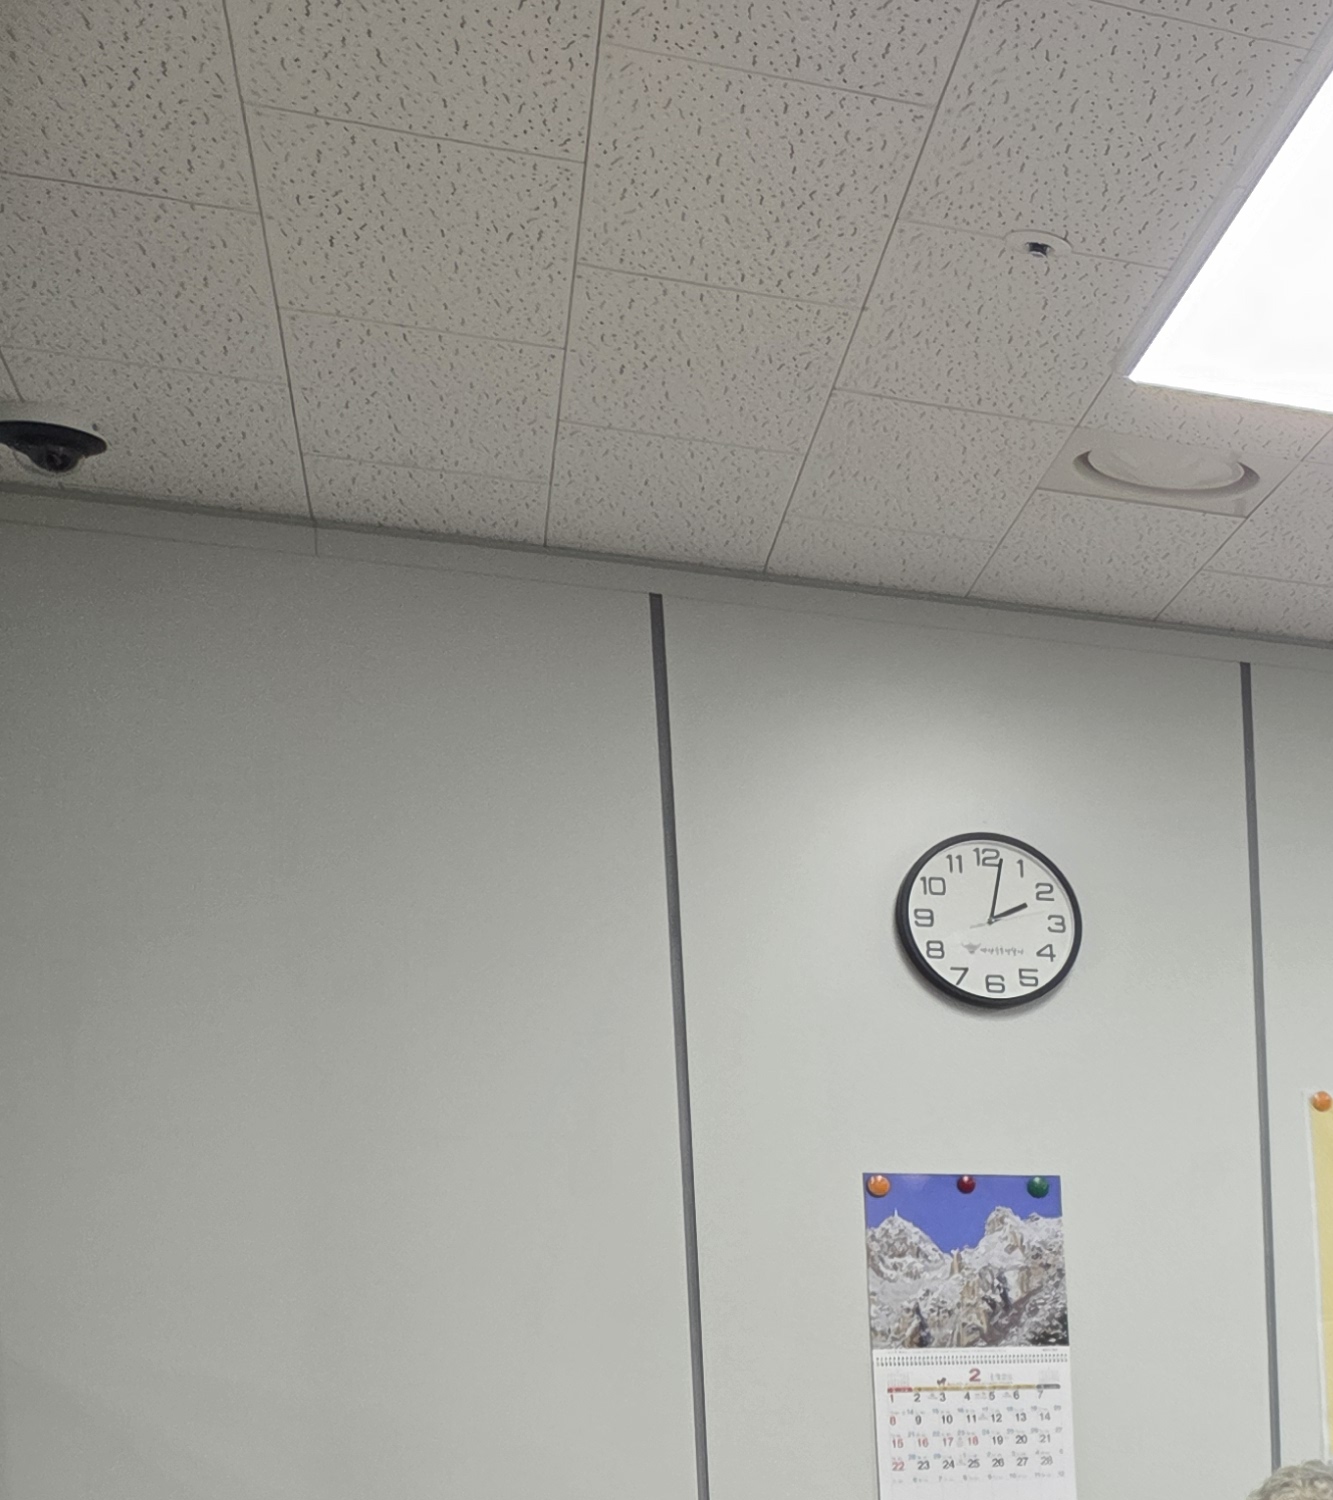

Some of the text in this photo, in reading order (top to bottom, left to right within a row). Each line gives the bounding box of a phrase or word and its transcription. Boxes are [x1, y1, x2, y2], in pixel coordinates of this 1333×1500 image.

[946, 854, 963, 873] 11
[973, 847, 1000, 867] 12
[1016, 859, 1024, 878] 1
[920, 876, 946, 895] 10
[1035, 882, 1055, 901] 2
[914, 908, 934, 927] 9
[1047, 915, 1066, 933] 3
[926, 940, 945, 959] 8
[1036, 944, 1056, 962] 4
[950, 967, 969, 985] 7
[985, 974, 1005, 993] 6
[1018, 968, 1038, 987] 5
[969, 1368, 981, 1381] 2
[889, 1390, 1043, 1403] 1 2 3 4 5 6 7
[889, 1412, 1051, 1426] 8 9 10 11 12 13 14
[892, 1434, 1051, 1448] 15 16 17 18 19 20 21
[892, 1455, 1053, 1471] 22 23 24 25 26 27 28
